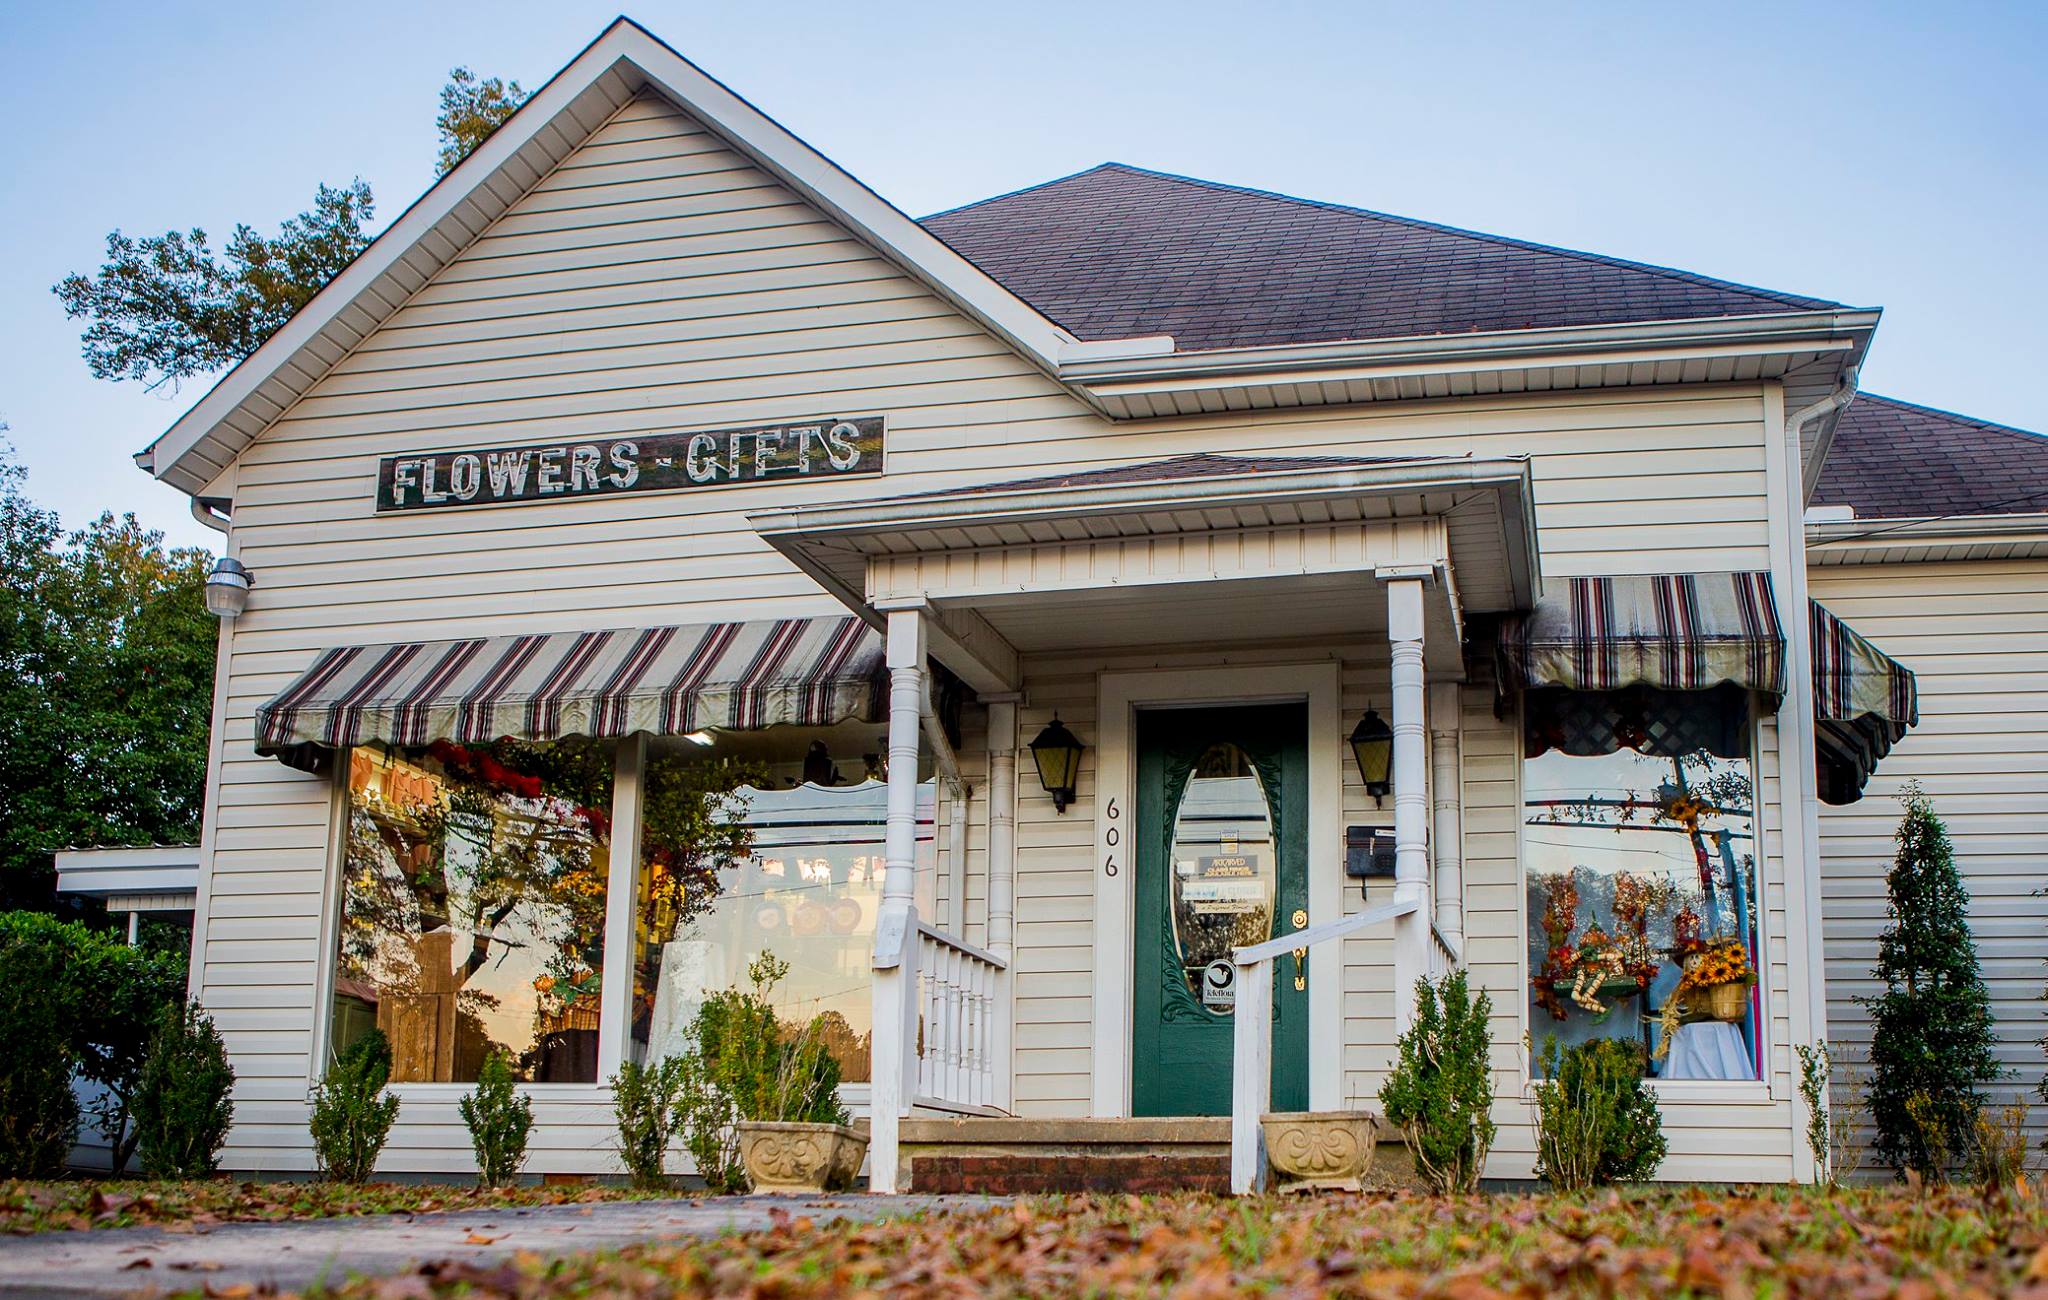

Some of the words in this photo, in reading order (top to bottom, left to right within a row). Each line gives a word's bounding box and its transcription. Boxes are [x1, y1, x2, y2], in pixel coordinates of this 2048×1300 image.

[393, 441, 640, 506] FLOWERS
[686, 421, 861, 483] GIFTS
[1105, 797, 1120, 877] 606
